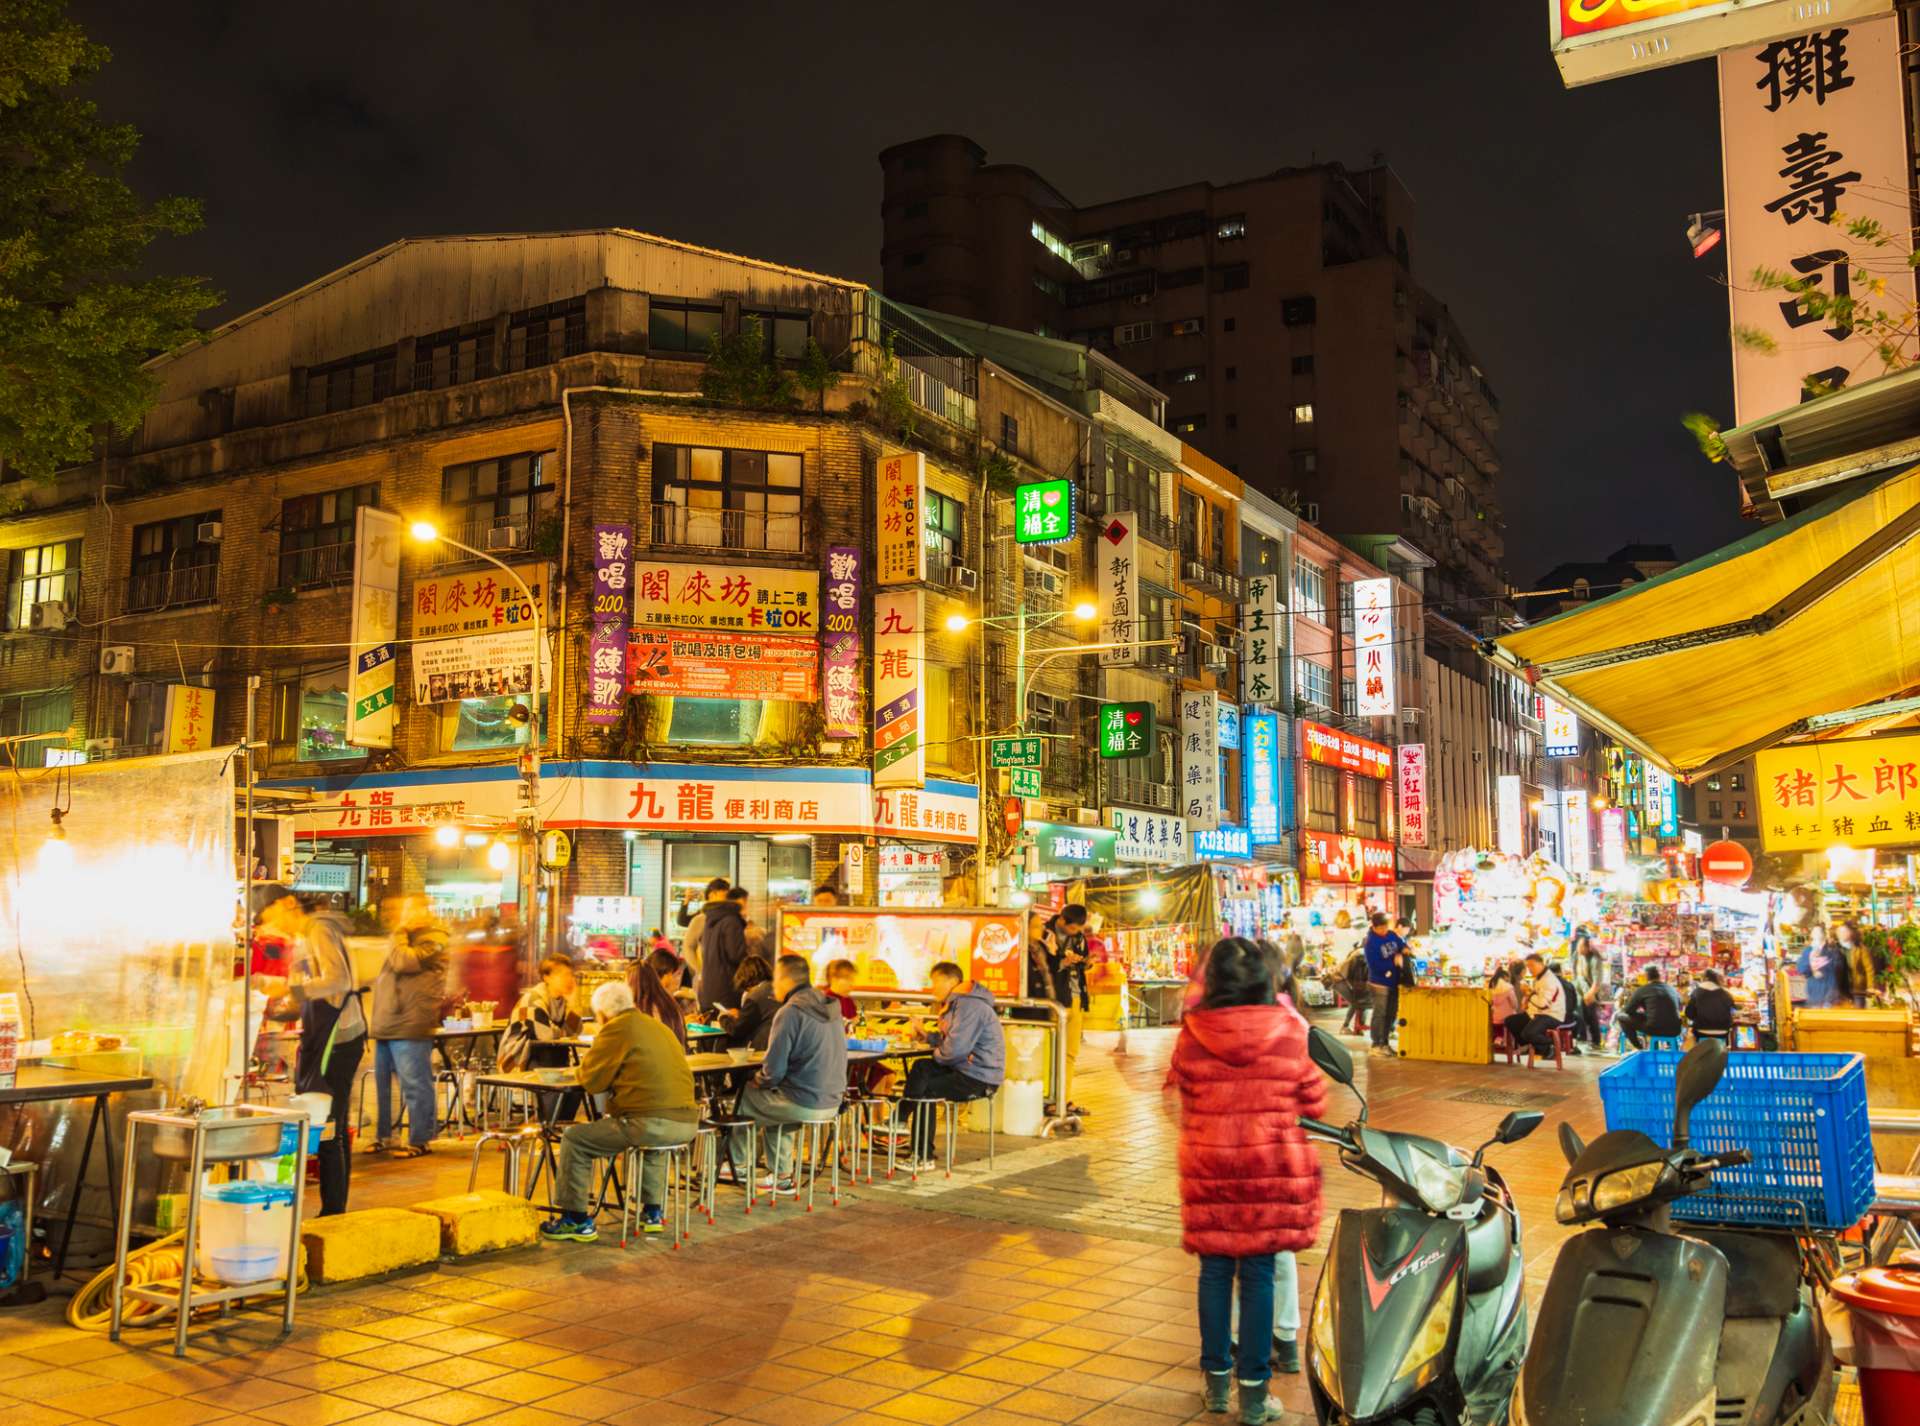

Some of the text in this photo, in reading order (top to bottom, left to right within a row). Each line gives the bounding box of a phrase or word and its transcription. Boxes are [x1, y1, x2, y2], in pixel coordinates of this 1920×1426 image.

[598, 532, 627, 589] 歡唱
[830, 553, 856, 609] 歡唱
[747, 607, 812, 628] 卡拉OK
[757, 589, 808, 607] 請上二樓
[879, 608, 913, 680] 九龍
[1249, 579, 1271, 697] 帝王茗茶
[362, 692, 388, 714] 文具
[593, 647, 623, 705] 練歌
[827, 666, 856, 721] 練歌
[1184, 700, 1202, 818] 健康藥局
[1773, 758, 1918, 809] 豬大郎
[1404, 778, 1421, 830] 紅珊瑚
